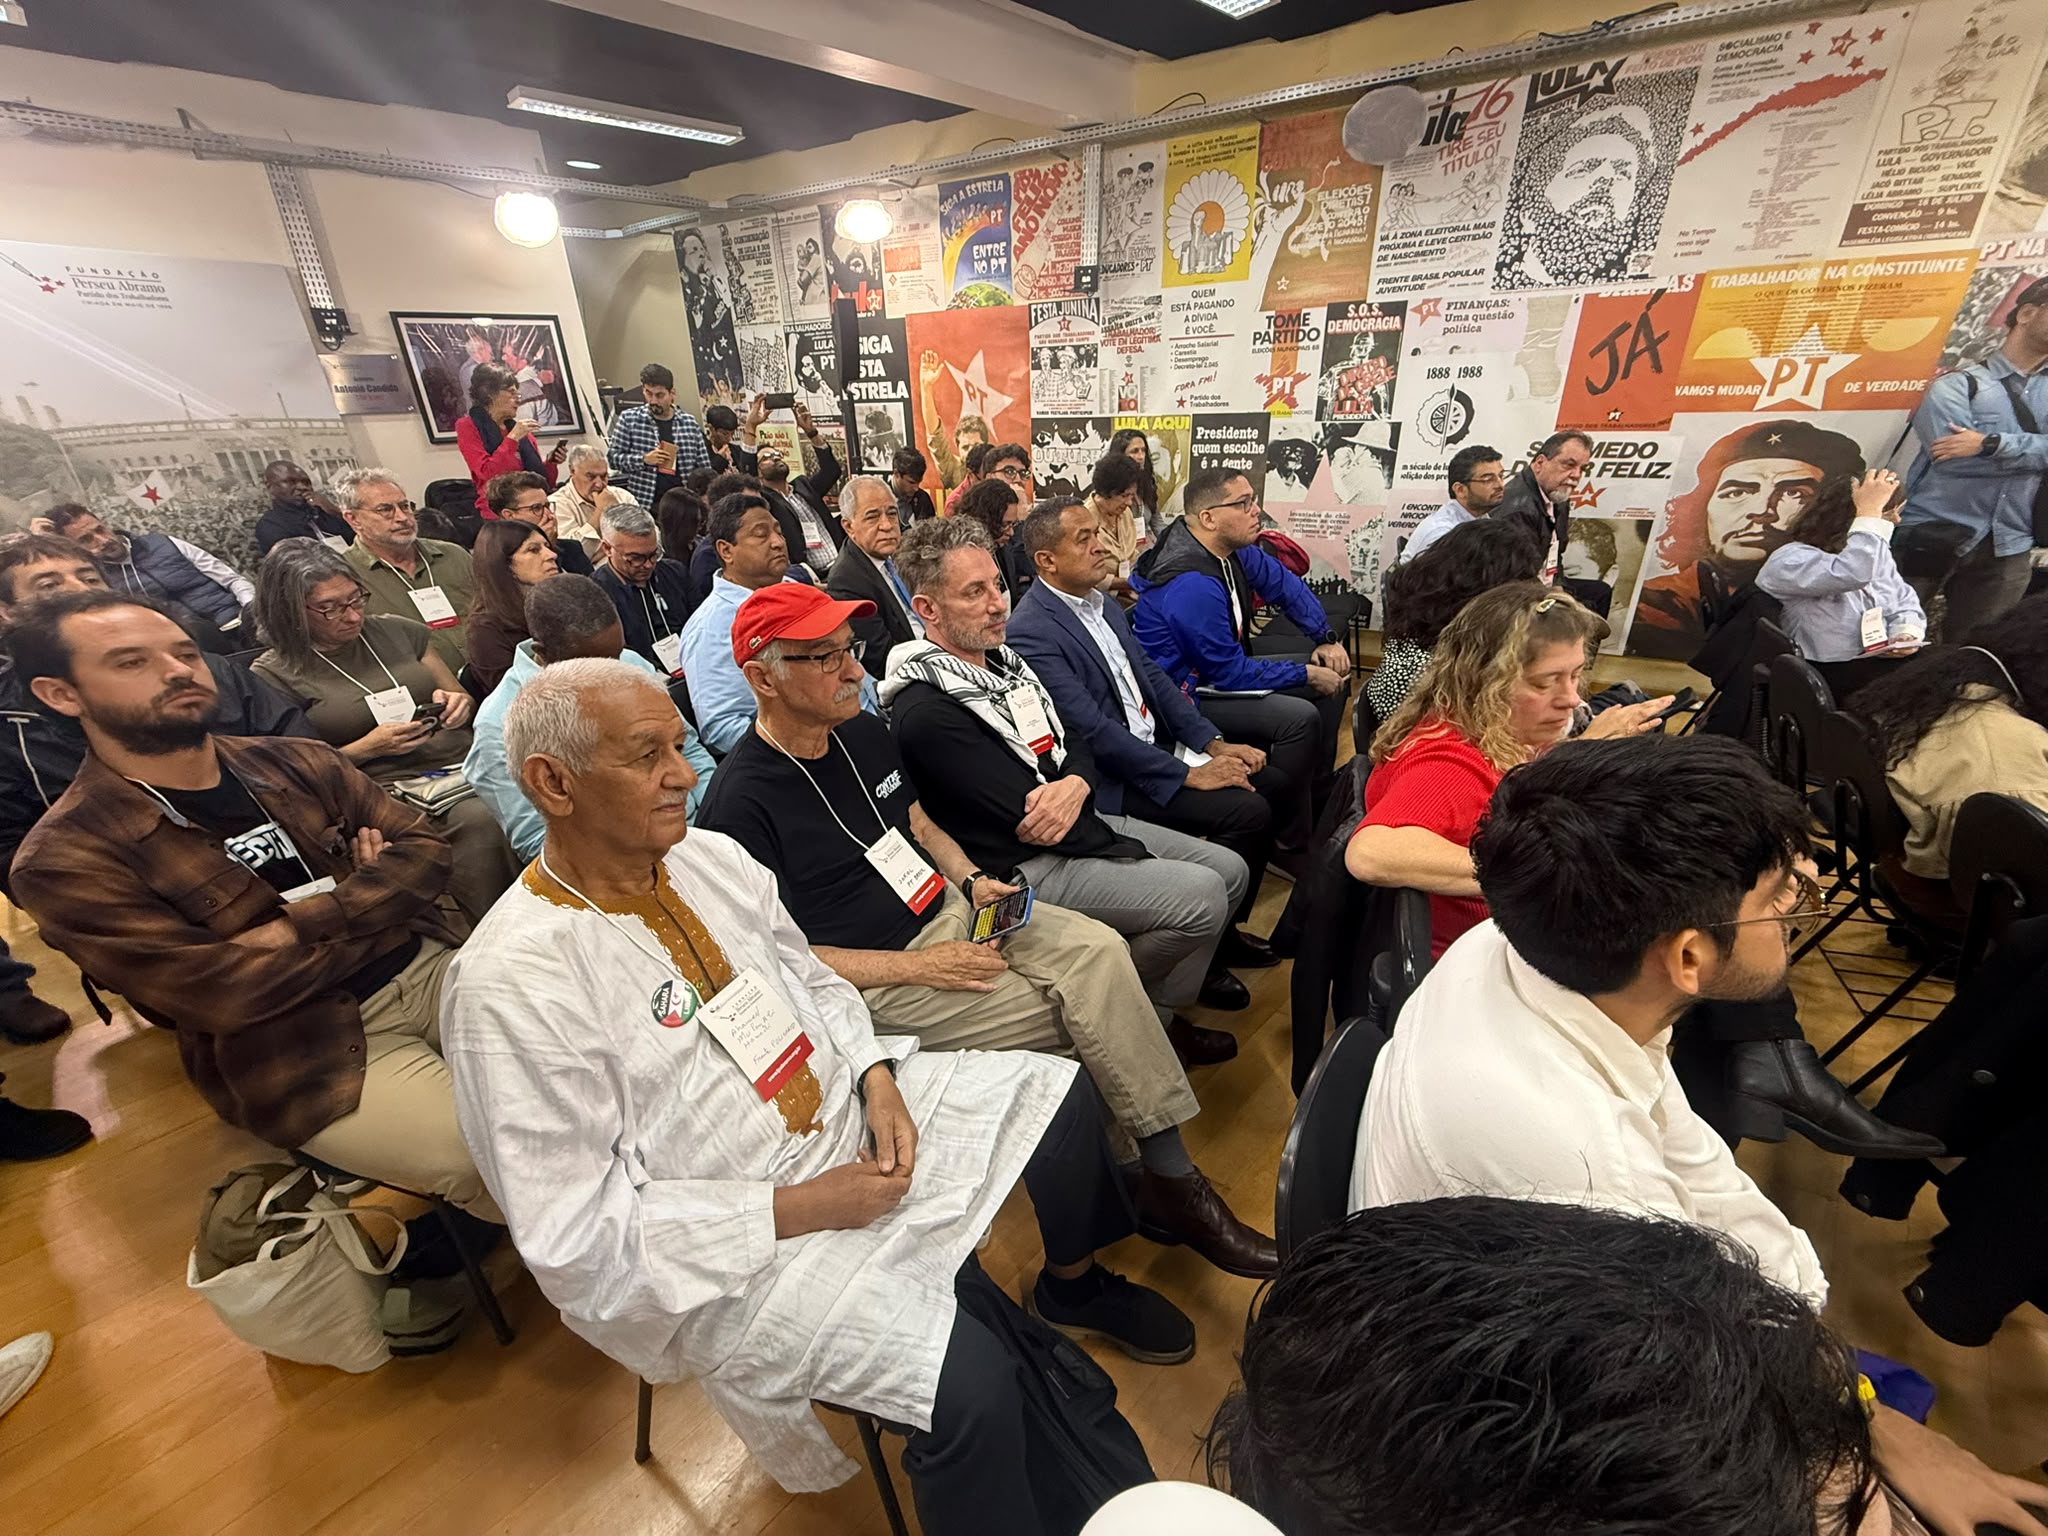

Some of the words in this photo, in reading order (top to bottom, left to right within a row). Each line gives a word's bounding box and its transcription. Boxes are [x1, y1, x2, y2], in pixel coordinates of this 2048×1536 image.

[1719, 33, 1782, 52] SOCIALISMO
[1784, 30, 1793, 40] E
[1716, 44, 1784, 63] DEMOCRACIA
[1524, 57, 1628, 114] LULA
[1438, 139, 1474, 163] TIRE
[1477, 123, 1507, 142] SEU
[1877, 147, 1911, 157] PARTIDO
[1912, 144, 1928, 152] DOS
[1930, 135, 1999, 150] TRABALHADORES
[1441, 141, 1501, 177] TÍTULO!
[1876, 156, 1902, 168] LULA
[1920, 146, 1993, 163] GOVERNADOR
[1881, 167, 1906, 177] HÉLIO
[1908, 164, 1940, 175] BICUDO
[1956, 160, 1977, 169] VICE
[1940, 171, 1982, 181] SENADOR
[965, 180, 1004, 198] ESTRELA
[1317, 184, 1373, 201] ELEIÇÕES
[1886, 188, 1923, 198] ABRAMO
[1938, 182, 1984, 193] SUPLENTE
[1863, 201, 1904, 211] DOMINGO
[1930, 197, 1943, 205] DE
[1944, 194, 1975, 204] JULHO
[990, 208, 1003, 223] PT
[1871, 210, 1923, 222] CONVENÇÃO
[1399, 229, 1422, 240] ZONA
[1424, 225, 1471, 236] ELEITORAL
[1472, 221, 1496, 230] MAIS
[1378, 241, 1417, 252] PRÓXIMA
[1425, 237, 1448, 246] LEVE
[1448, 231, 1493, 244] CERTIDÃO
[972, 241, 1007, 260] ENTRE
[1377, 254, 1390, 262] DE
[1391, 247, 1447, 261] NASCIMENTO
[1979, 240, 2013, 261] PT
[65, 266, 160, 279] FUNDAÇÃO
[974, 260, 988, 275] NO
[990, 257, 1007, 274] PT
[1100, 261, 1135, 274] DUCADORES
[1140, 258, 1154, 272] PT
[1710, 266, 1822, 289] TRABALHADOR
[1824, 262, 1850, 280] NA
[1852, 256, 1969, 278] CONSTITUINTE
[1377, 275, 1410, 286] FRENTE
[1411, 272, 1441, 283] BRASIL
[1441, 268, 1486, 279] POPULAR
[72, 277, 115, 291] Perseu
[119, 280, 166, 294] Abramo
[1191, 288, 1216, 299] QUEM
[1375, 283, 1427, 295] JUVENTUDE
[1786, 288, 1798, 296] OS
[1800, 285, 1855, 295] GOVERNOS
[1857, 281, 1903, 291] FIZERAM
[77, 290, 105, 299] Partido
[106, 291, 119, 300] dos
[121, 292, 170, 302] Trabalhadores
[1031, 304, 1058, 326] FESTA
[1059, 299, 1098, 322] JUNINA
[1170, 301, 1192, 312] ESTÁ
[1193, 298, 1235, 311] PAGANDO
[1347, 303, 1383, 317] S.O.S.
[1421, 301, 1435, 315] PT
[1446, 299, 1511, 311] FINANÇAS:
[1184, 315, 1191, 323] A
[1191, 312, 1218, 323] DÍVIDA
[1265, 312, 1311, 329] TOME
[1327, 315, 1401, 334] DEMOCRACIA
[1444, 313, 1471, 323] Uma
[1472, 311, 1515, 323] questão
[1185, 325, 1190, 335] É
[1252, 328, 1321, 346] PARTIDO
[1442, 325, 1482, 336] política
[813, 339, 834, 351] LULA
[1100, 339, 1117, 347] VOTE
[1174, 342, 1197, 350] Arrocho
[1197, 340, 1219, 348] Salarial
[1252, 346, 1275, 354] ELEIÇÕES
[1277, 345, 1311, 353] MUNICIPAIS
[1585, 288, 1670, 396] JÁ
[820, 355, 836, 371] PT
[1174, 356, 1209, 364] Desemprego
[1174, 362, 1203, 370] Decreto-lei
[860, 359, 887, 378] STA
[1426, 366, 1451, 380] 1888
[1457, 365, 1484, 379] 1988
[1767, 356, 1830, 397] PT
[334, 384, 366, 394] Antonio
[366, 384, 399, 393] Candido
[1174, 378, 1196, 393] FORA
[1198, 370, 1218, 386] FMI!
[1272, 376, 1294, 395] PT
[1844, 382, 1862, 394] DE
[1865, 379, 1929, 392] VERDADE
[963, 379, 988, 415] PT
[1674, 384, 1716, 397] VAMOS
[1717, 383, 1762, 396] MUDAR
[1189, 400, 1230, 408] Trabalhadores
[1114, 416, 1149, 430] LULA
[1152, 415, 1190, 430] AQUI
[1608, 411, 1622, 421] PT
[1195, 425, 1259, 440] Presidente
[1033, 447, 1102, 465] OUTUBR
[1192, 442, 1221, 457] quem
[1222, 440, 1265, 454] escolhe
[1200, 456, 1207, 469] é
[1211, 460, 1218, 468] a
[1222, 456, 1253, 470] gente
[1409, 461, 1433, 470] século
[1433, 462, 1442, 470] de
[1596, 461, 1673, 480] FELIZ.
[1423, 471, 1435, 480] dos
